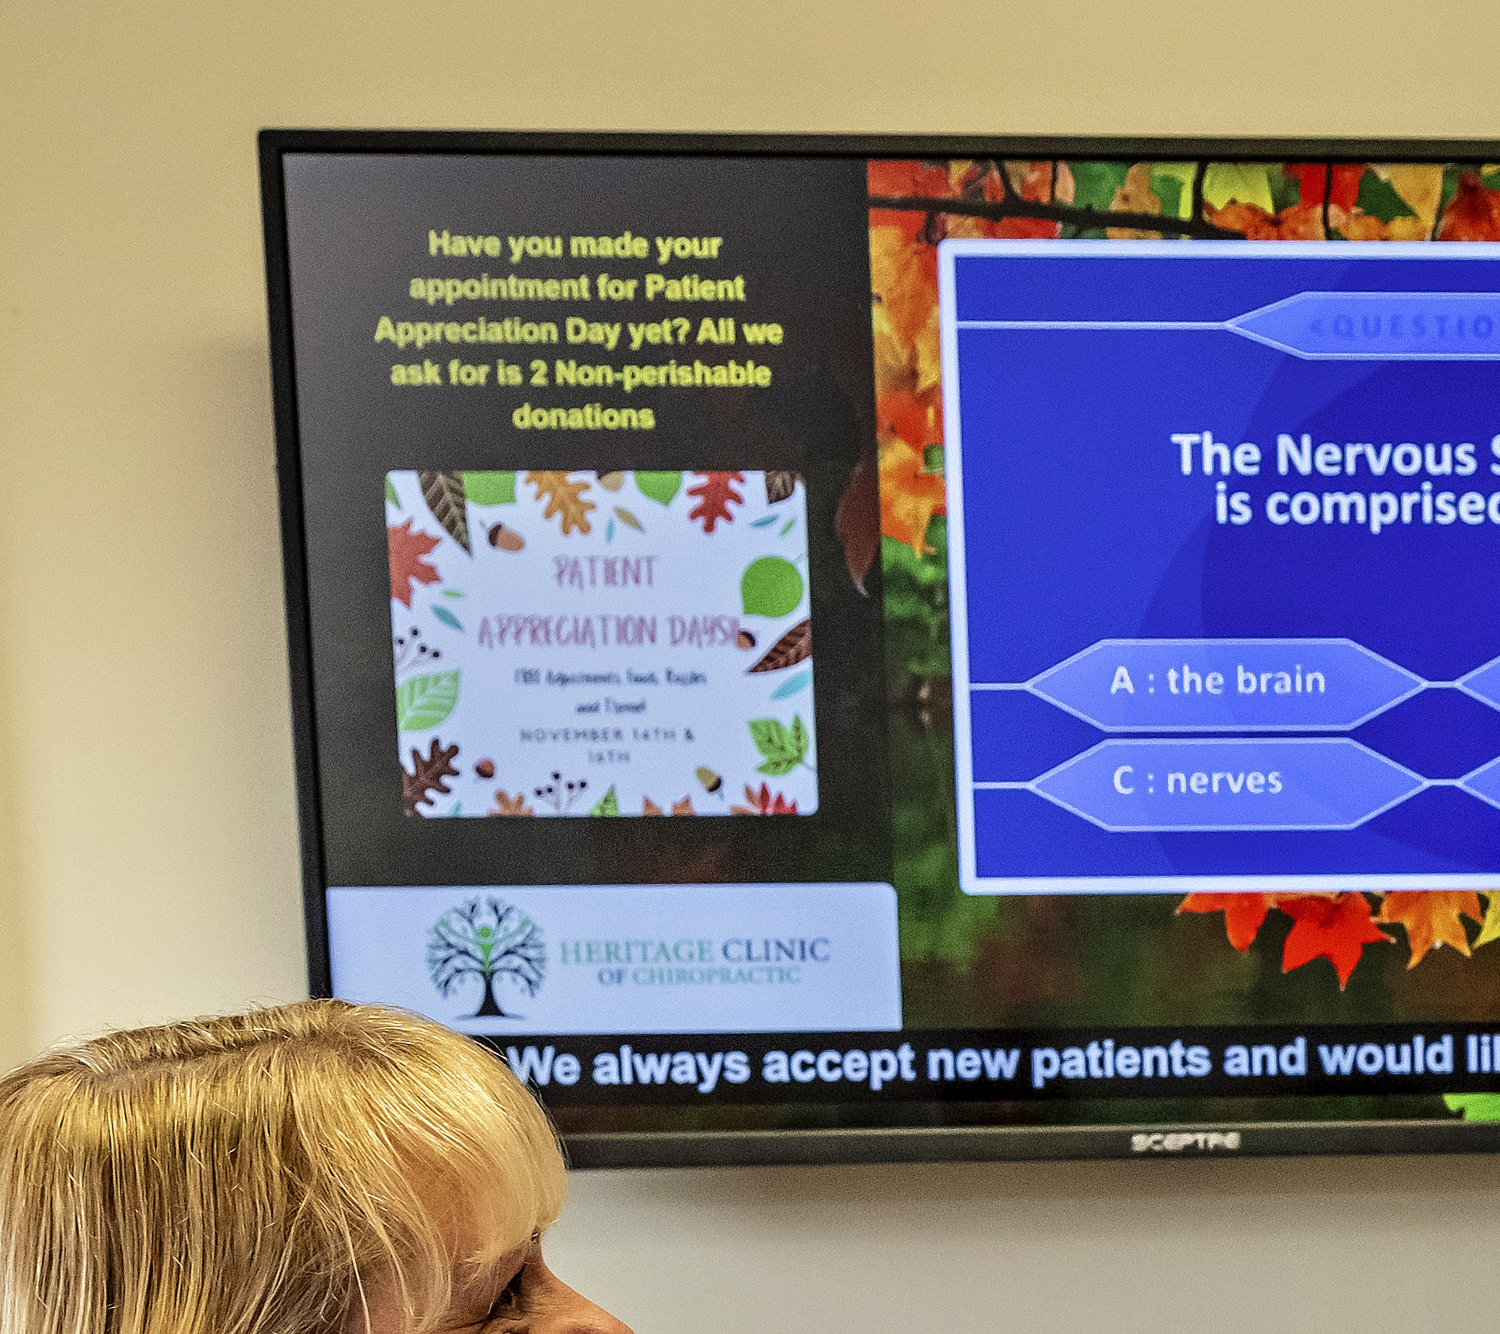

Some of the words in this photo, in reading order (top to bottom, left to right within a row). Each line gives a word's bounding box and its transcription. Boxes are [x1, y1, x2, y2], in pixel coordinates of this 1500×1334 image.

[428, 230, 501, 257] Have
[509, 233, 562, 264] you
[570, 232, 649, 258] made
[657, 234, 722, 262] your
[410, 275, 590, 304] appointment
[597, 275, 637, 300] for
[645, 275, 745, 300] Patient
[375, 318, 558, 347] Appreciation
[566, 319, 620, 349] Day
[629, 318, 690, 349] yet?
[697, 318, 735, 344] All
[743, 322, 784, 344] we
[391, 361, 441, 386] ask
[448, 361, 491, 385] for
[497, 361, 523, 386] is
[530, 361, 548, 385] 2
[555, 361, 772, 391] Non-perishable
[512, 403, 655, 429] donations
[1170, 431, 1262, 476] The
[1276, 433, 1478, 476] Nervous
[1216, 481, 1253, 524] is
[553, 555, 658, 589] PATIENT
[477, 613, 657, 649] APPRECIATION
[1110, 666, 1135, 695] A
[1168, 664, 1224, 694] the
[1237, 664, 1326, 694] brain
[519, 728, 623, 742] NOVEMBER
[1113, 765, 1134, 795] C
[1167, 771, 1283, 794] nerves
[560, 940, 714, 964] HERITAGE
[722, 937, 830, 963] CLINIC
[597, 967, 625, 985] OF
[633, 966, 801, 985] CHIROPRACTIC
[506, 1045, 581, 1086] We
[592, 1045, 751, 1092] always
[761, 1042, 916, 1090] accept
[926, 1049, 1019, 1081] new
[1031, 1039, 1212, 1088] patients
[1224, 1037, 1308, 1077] and
[1317, 1035, 1454, 1075] would
